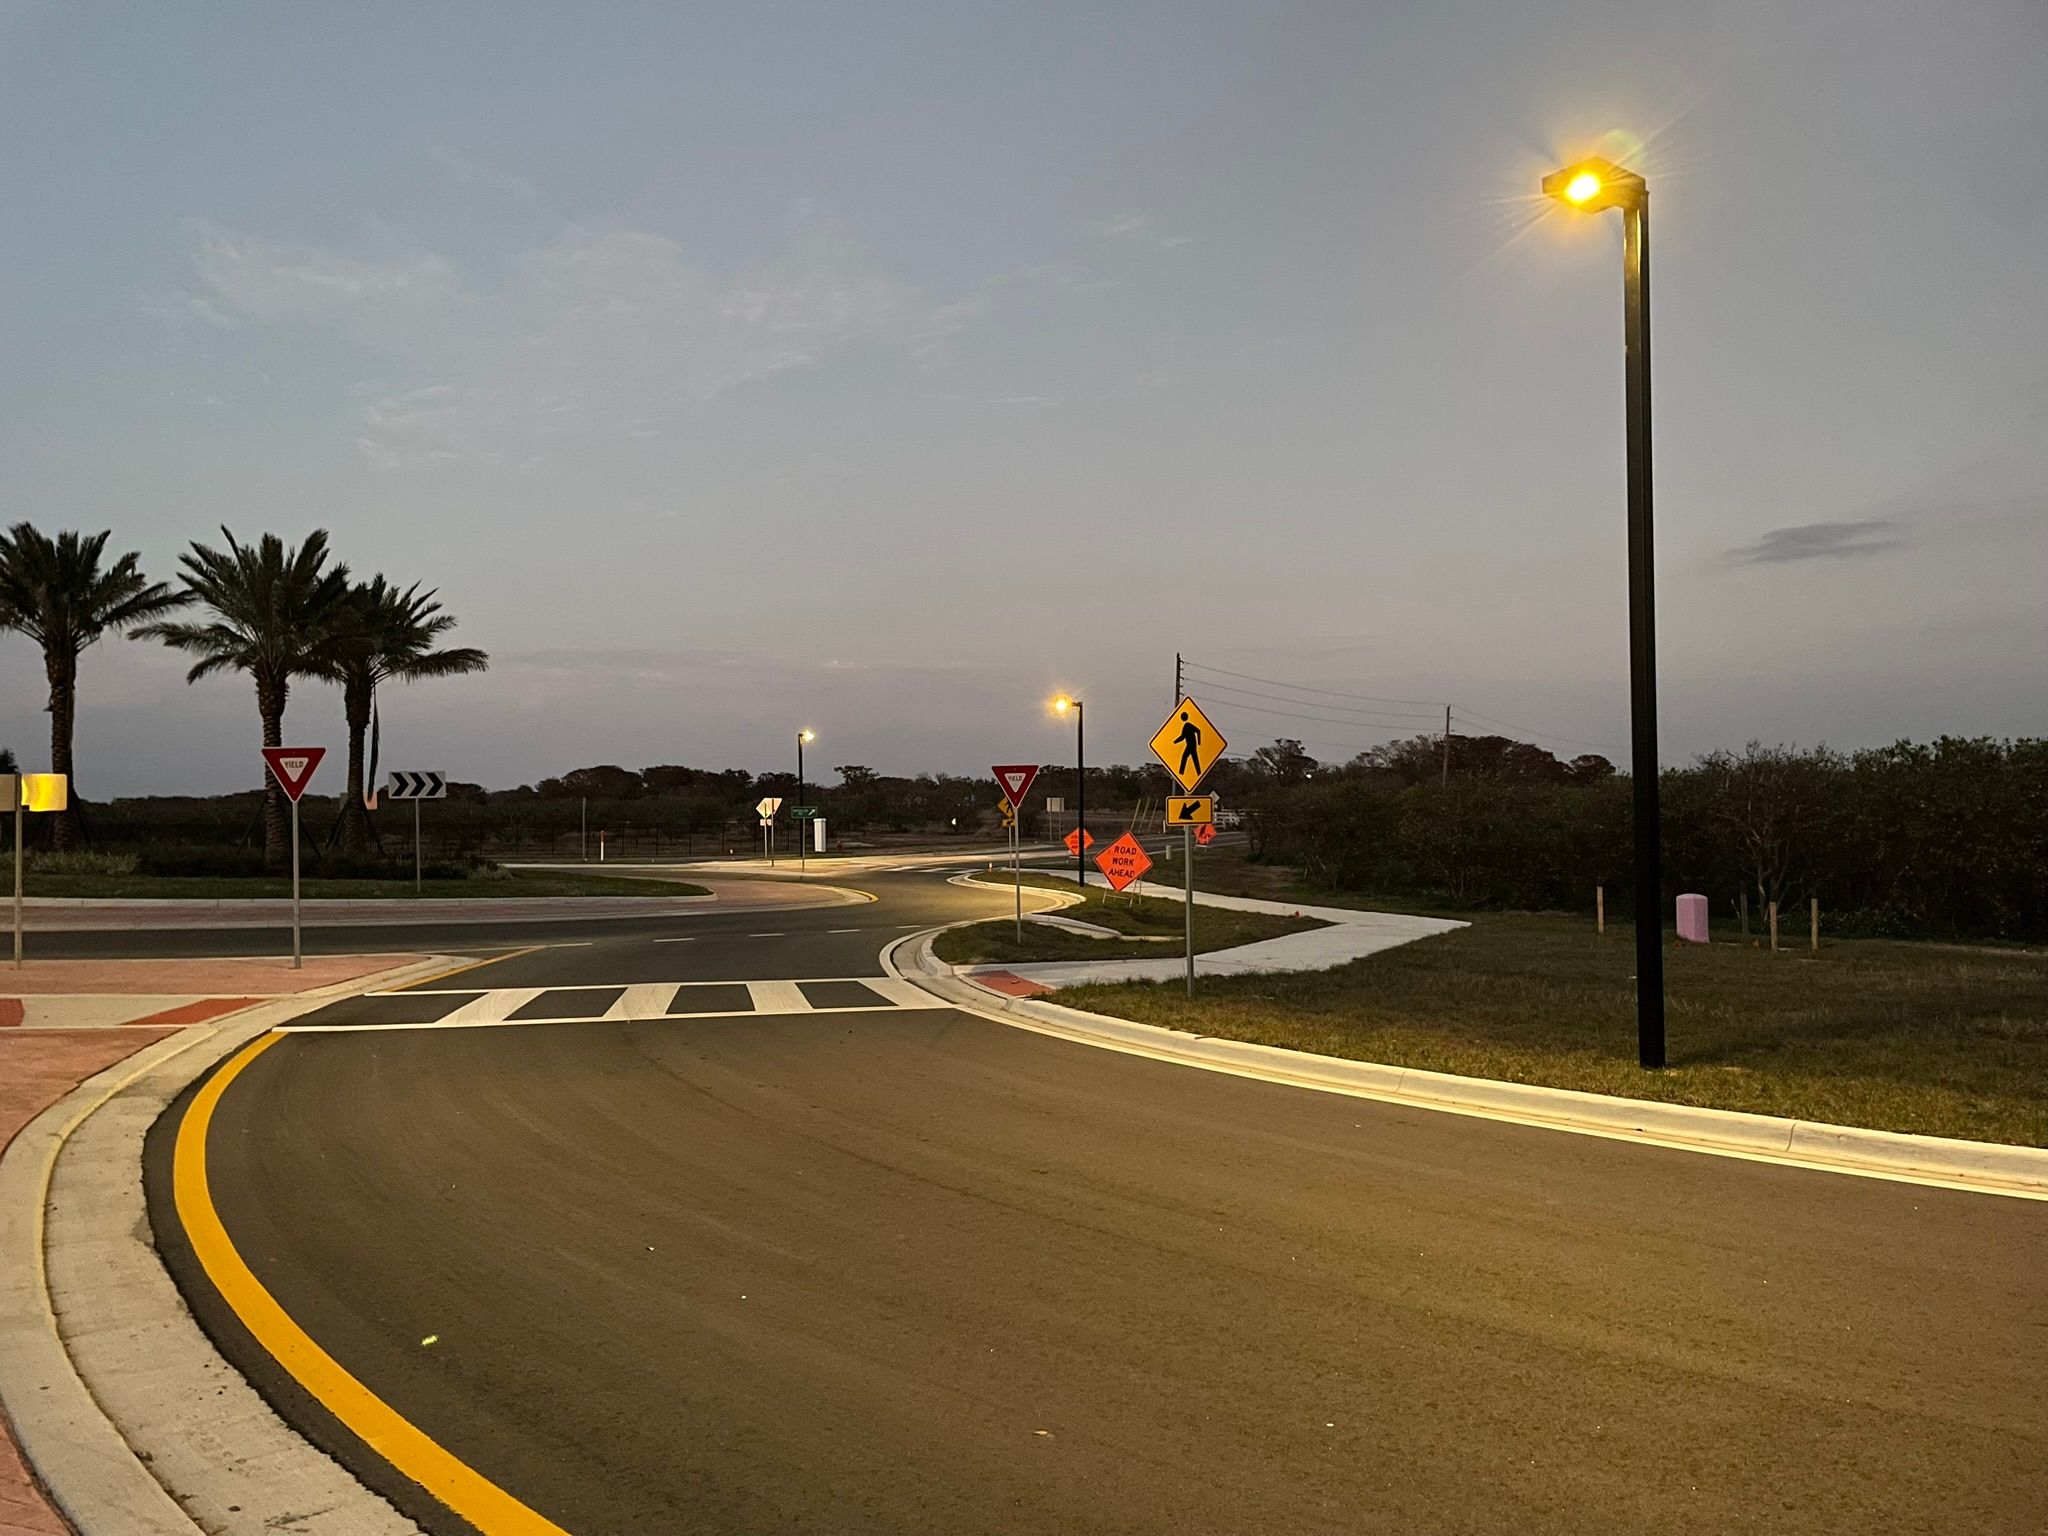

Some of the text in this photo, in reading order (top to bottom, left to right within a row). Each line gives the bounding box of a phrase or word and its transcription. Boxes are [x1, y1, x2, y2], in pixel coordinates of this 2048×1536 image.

[1114, 845, 1137, 855] ROAD
[1112, 857, 1135, 866] WORK
[1108, 868, 1135, 878] AHEAD
